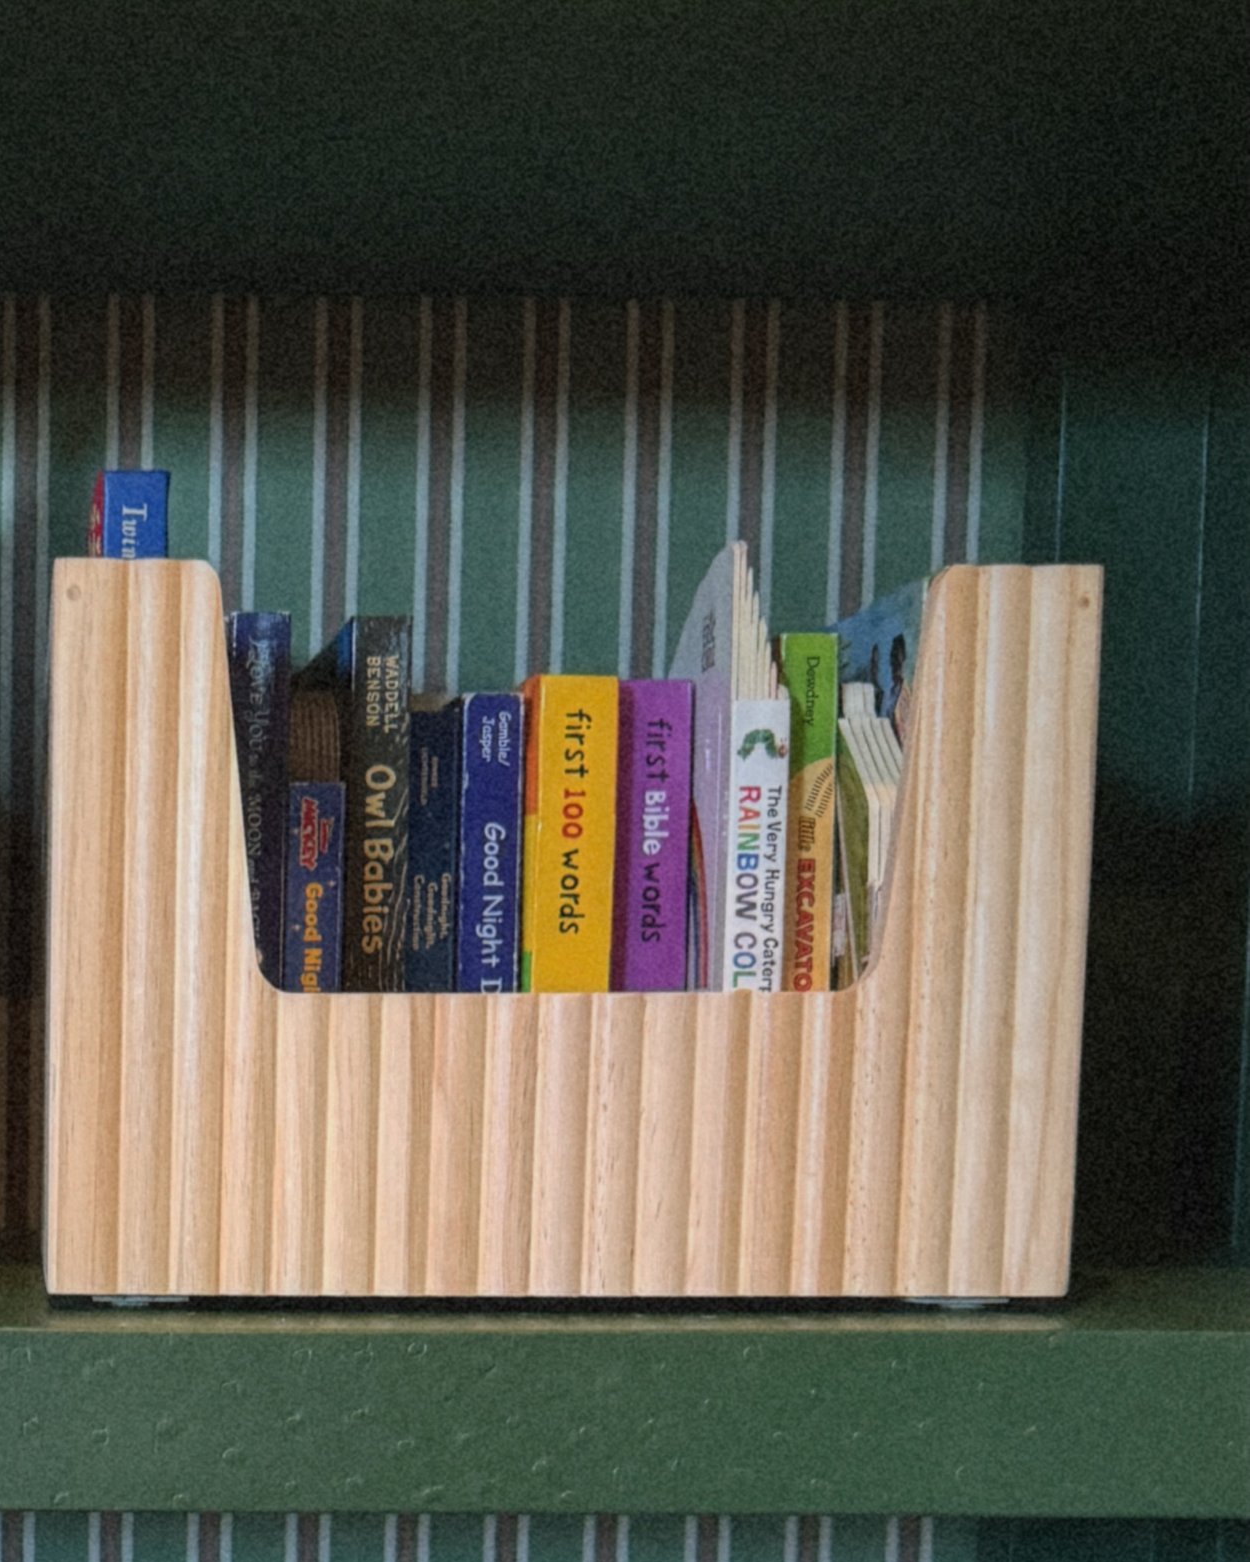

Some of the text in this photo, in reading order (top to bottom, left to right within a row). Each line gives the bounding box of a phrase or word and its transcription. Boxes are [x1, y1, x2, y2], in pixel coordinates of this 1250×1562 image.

[367, 656, 381, 726] BENSON
[384, 654, 400, 733] WADDELL
[480, 716, 494, 762] Jasper
[497, 711, 511, 766] Gamble/
[559, 708, 591, 934] first 100 words
[641, 718, 671, 944] first Bible words
[765, 786, 781, 818] The
[362, 764, 396, 954] Owl Babies
[482, 822, 505, 887] Good
[762, 821, 781, 863] Very
[304, 882, 322, 942] Good
[733, 786, 761, 988] RAINBOW COL
[760, 869, 779, 933] Hungry
[476, 894, 503, 968] Night
